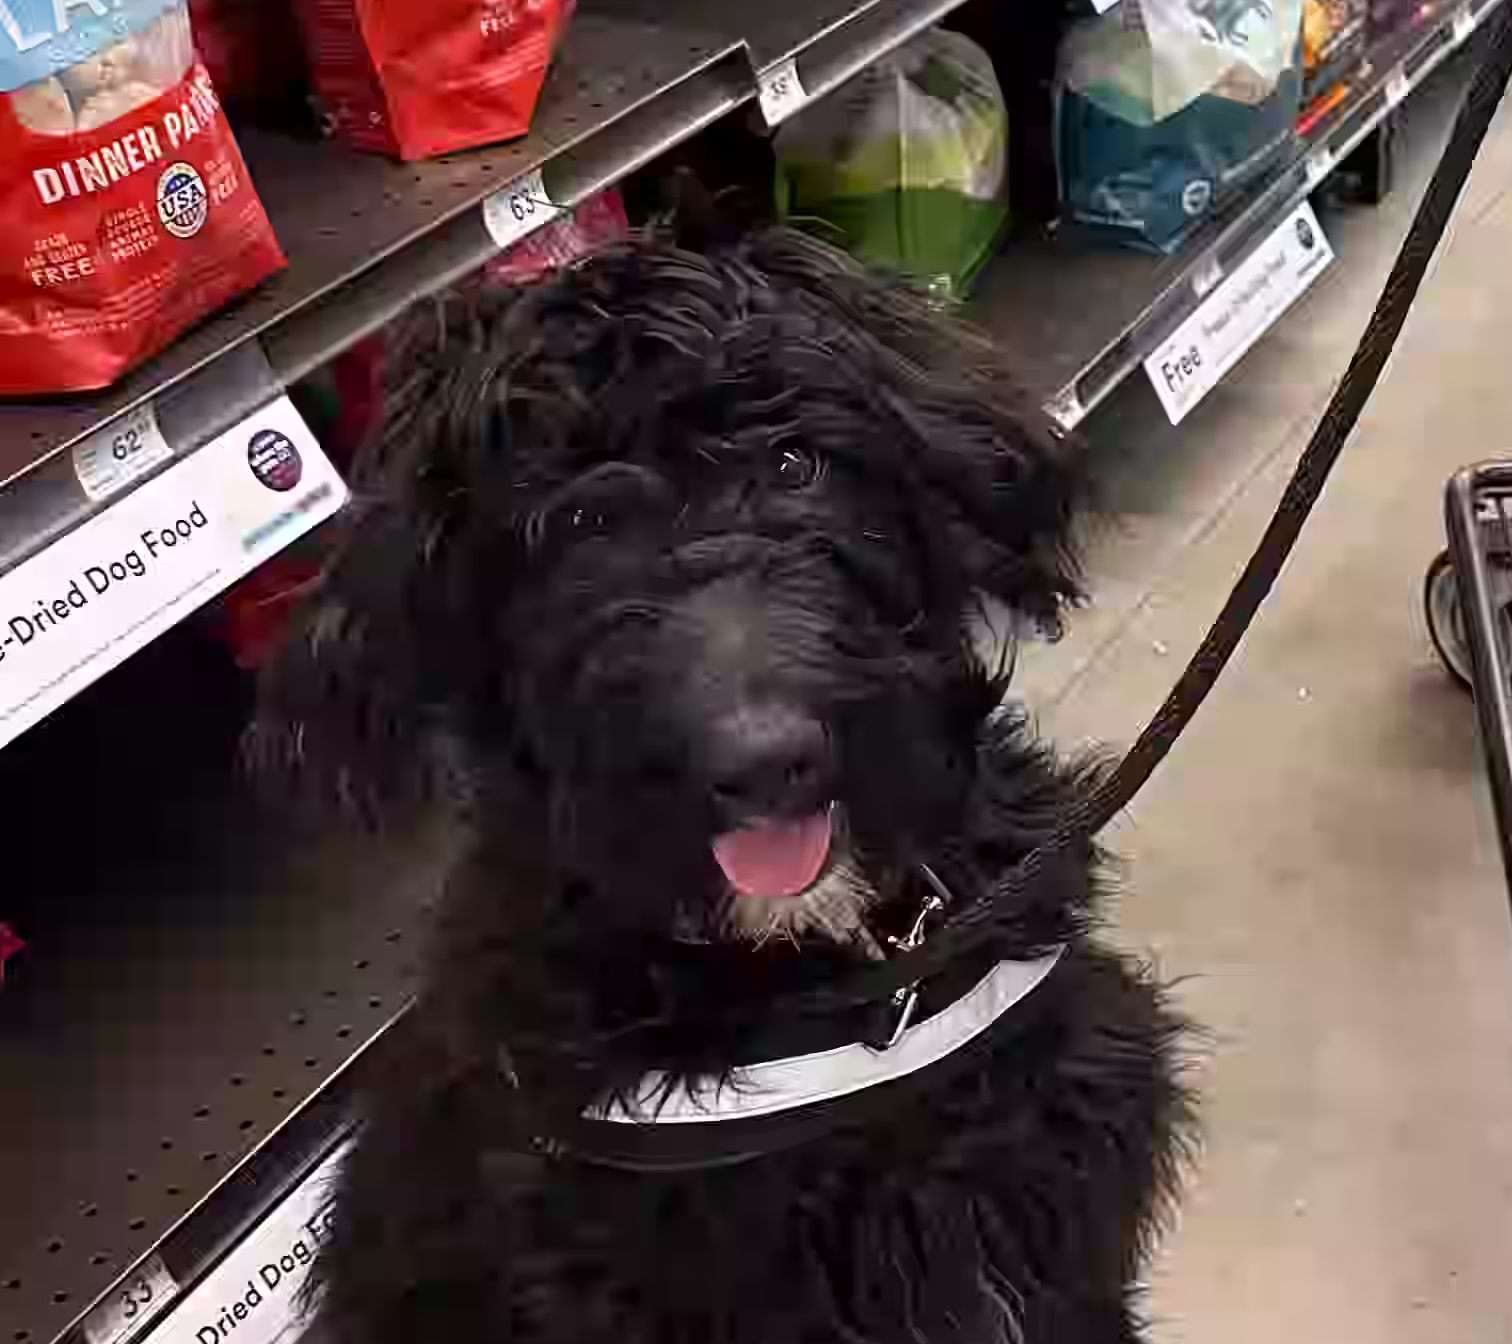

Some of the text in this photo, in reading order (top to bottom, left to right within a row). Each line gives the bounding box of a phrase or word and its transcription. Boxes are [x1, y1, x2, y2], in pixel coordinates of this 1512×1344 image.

[32, 124, 163, 206] DINNER
[160, 183, 204, 222] USA
[32, 256, 95, 288] FREE
[1161, 344, 1203, 393] Free
[84, 549, 146, 596] Dog
[140, 499, 209, 558] Food
[259, 1238, 313, 1291] Dog
